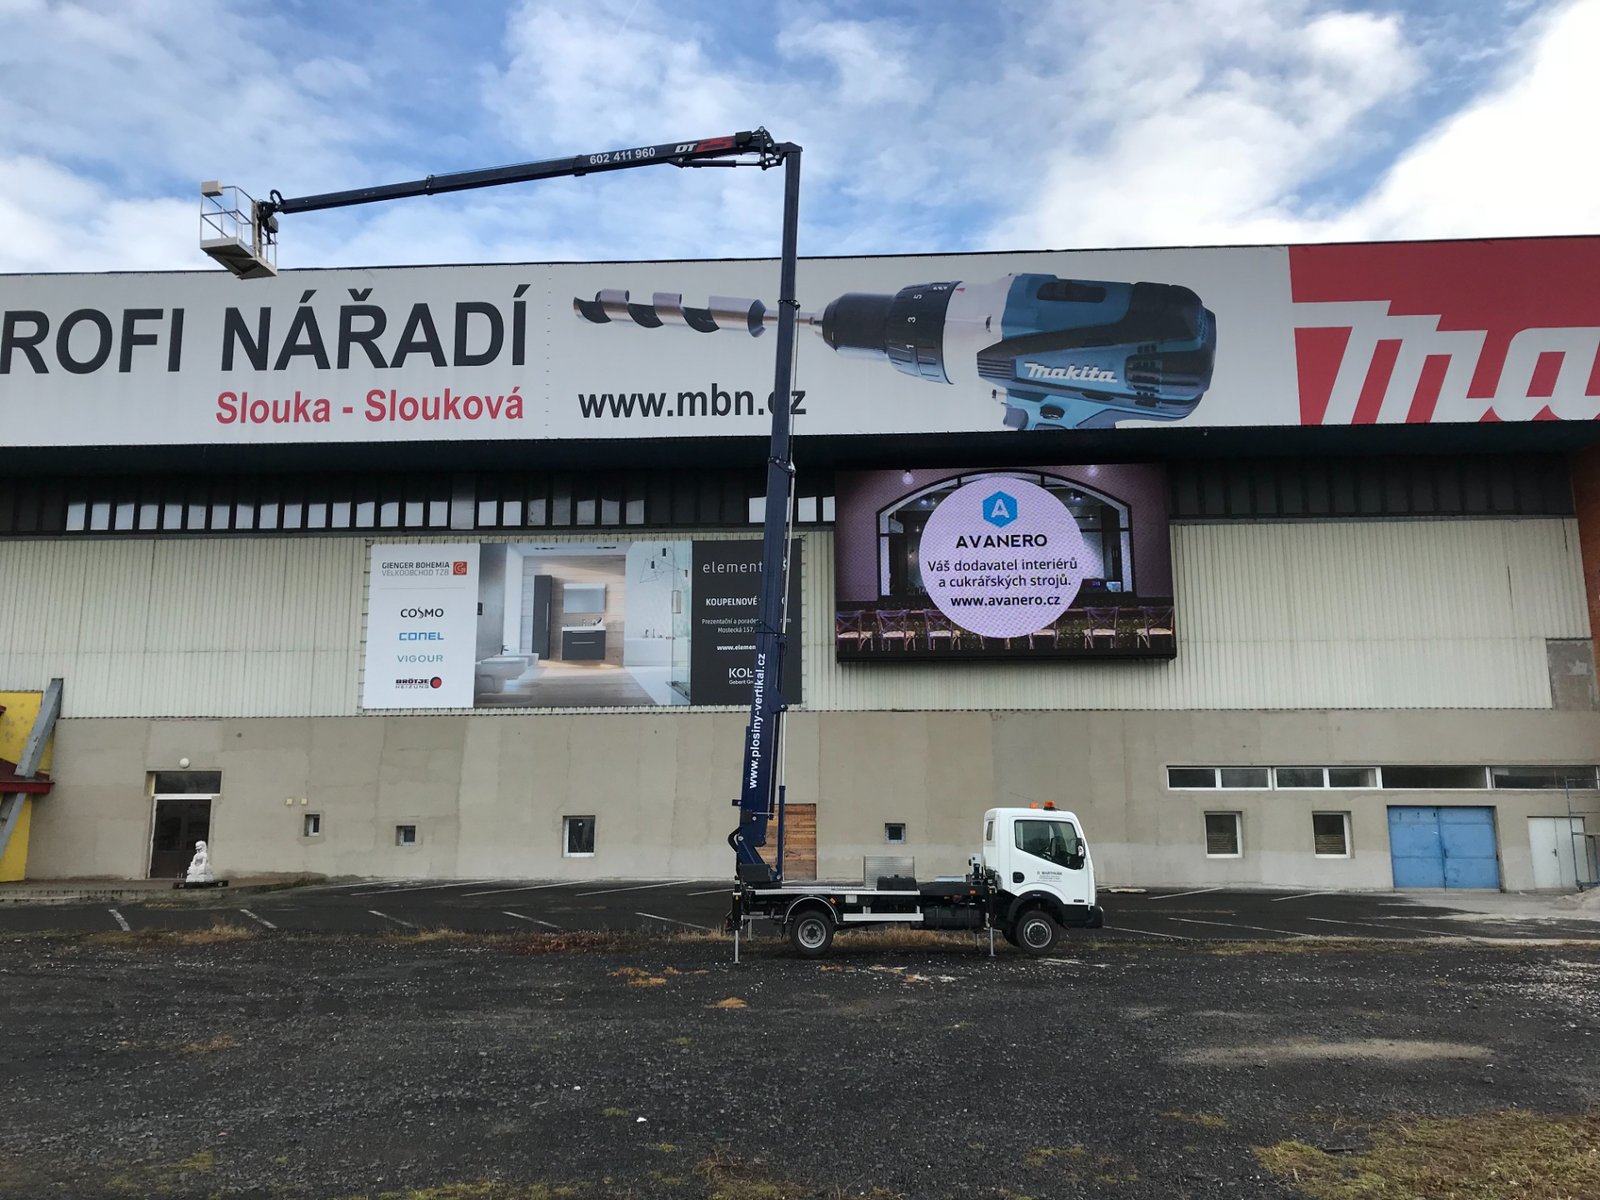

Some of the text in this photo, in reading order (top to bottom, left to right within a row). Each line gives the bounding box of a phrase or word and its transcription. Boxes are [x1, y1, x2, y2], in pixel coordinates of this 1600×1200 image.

[589, 147, 656, 165] 602 411 960
[0, 283, 532, 374] ROFI NÁŘADÍ
[215, 390, 331, 425] Slouka
[363, 386, 525, 423] Slouková
[955, 533, 1048, 549] AVANERO
[381, 561, 414, 569] GIENGER
[702, 560, 763, 574] element
[927, 556, 1078, 572] Váš dodavatel interiérů
[381, 569, 434, 577] VELKOOBCHOD
[938, 573, 1072, 590] a cukrářských strojů.
[705, 595, 758, 606] KOUPELNOVÉ
[950, 595, 1061, 607] www.avanero.cz
[400, 606, 444, 619] COSMO
[397, 654, 444, 663] VIGOUR
[749, 653, 766, 789] www.plosiny-vertikal.cz
